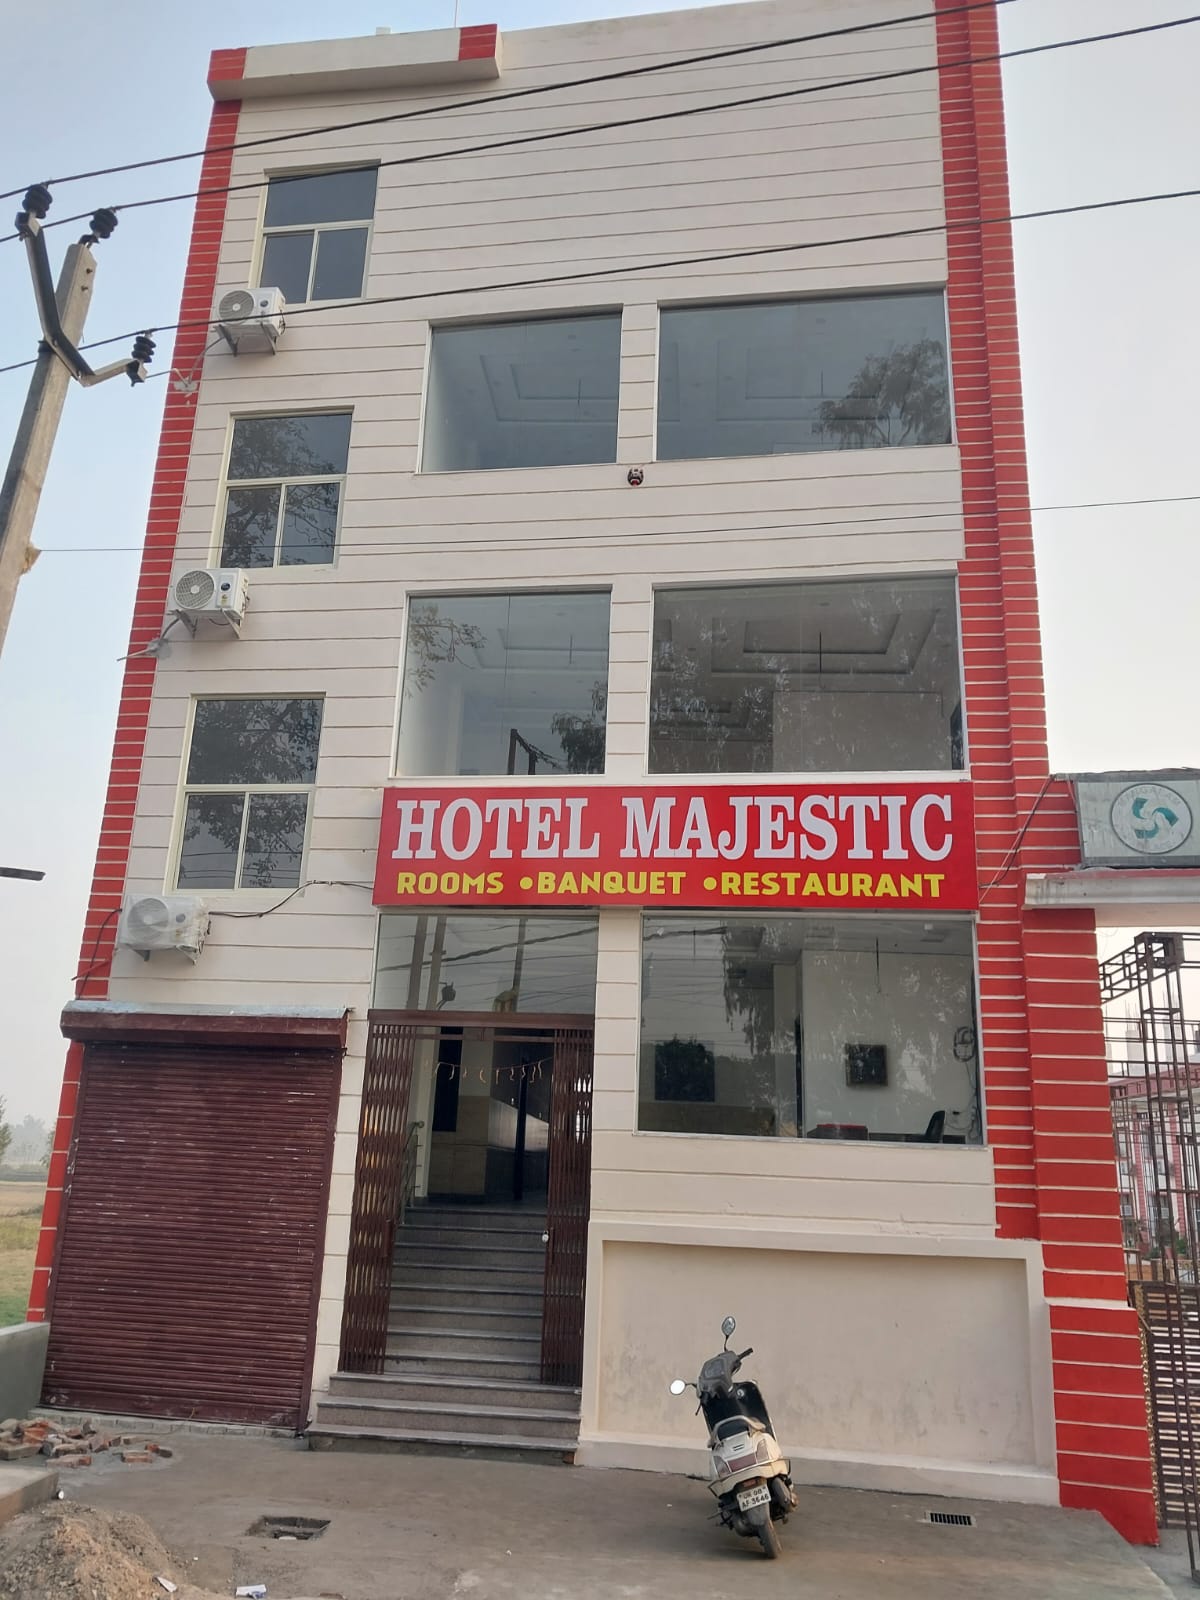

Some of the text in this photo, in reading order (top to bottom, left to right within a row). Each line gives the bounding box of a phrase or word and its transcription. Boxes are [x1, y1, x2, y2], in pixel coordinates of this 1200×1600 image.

[391, 793, 953, 861] HOTEL MAJESTIC
[397, 872, 504, 895] ROOMS
